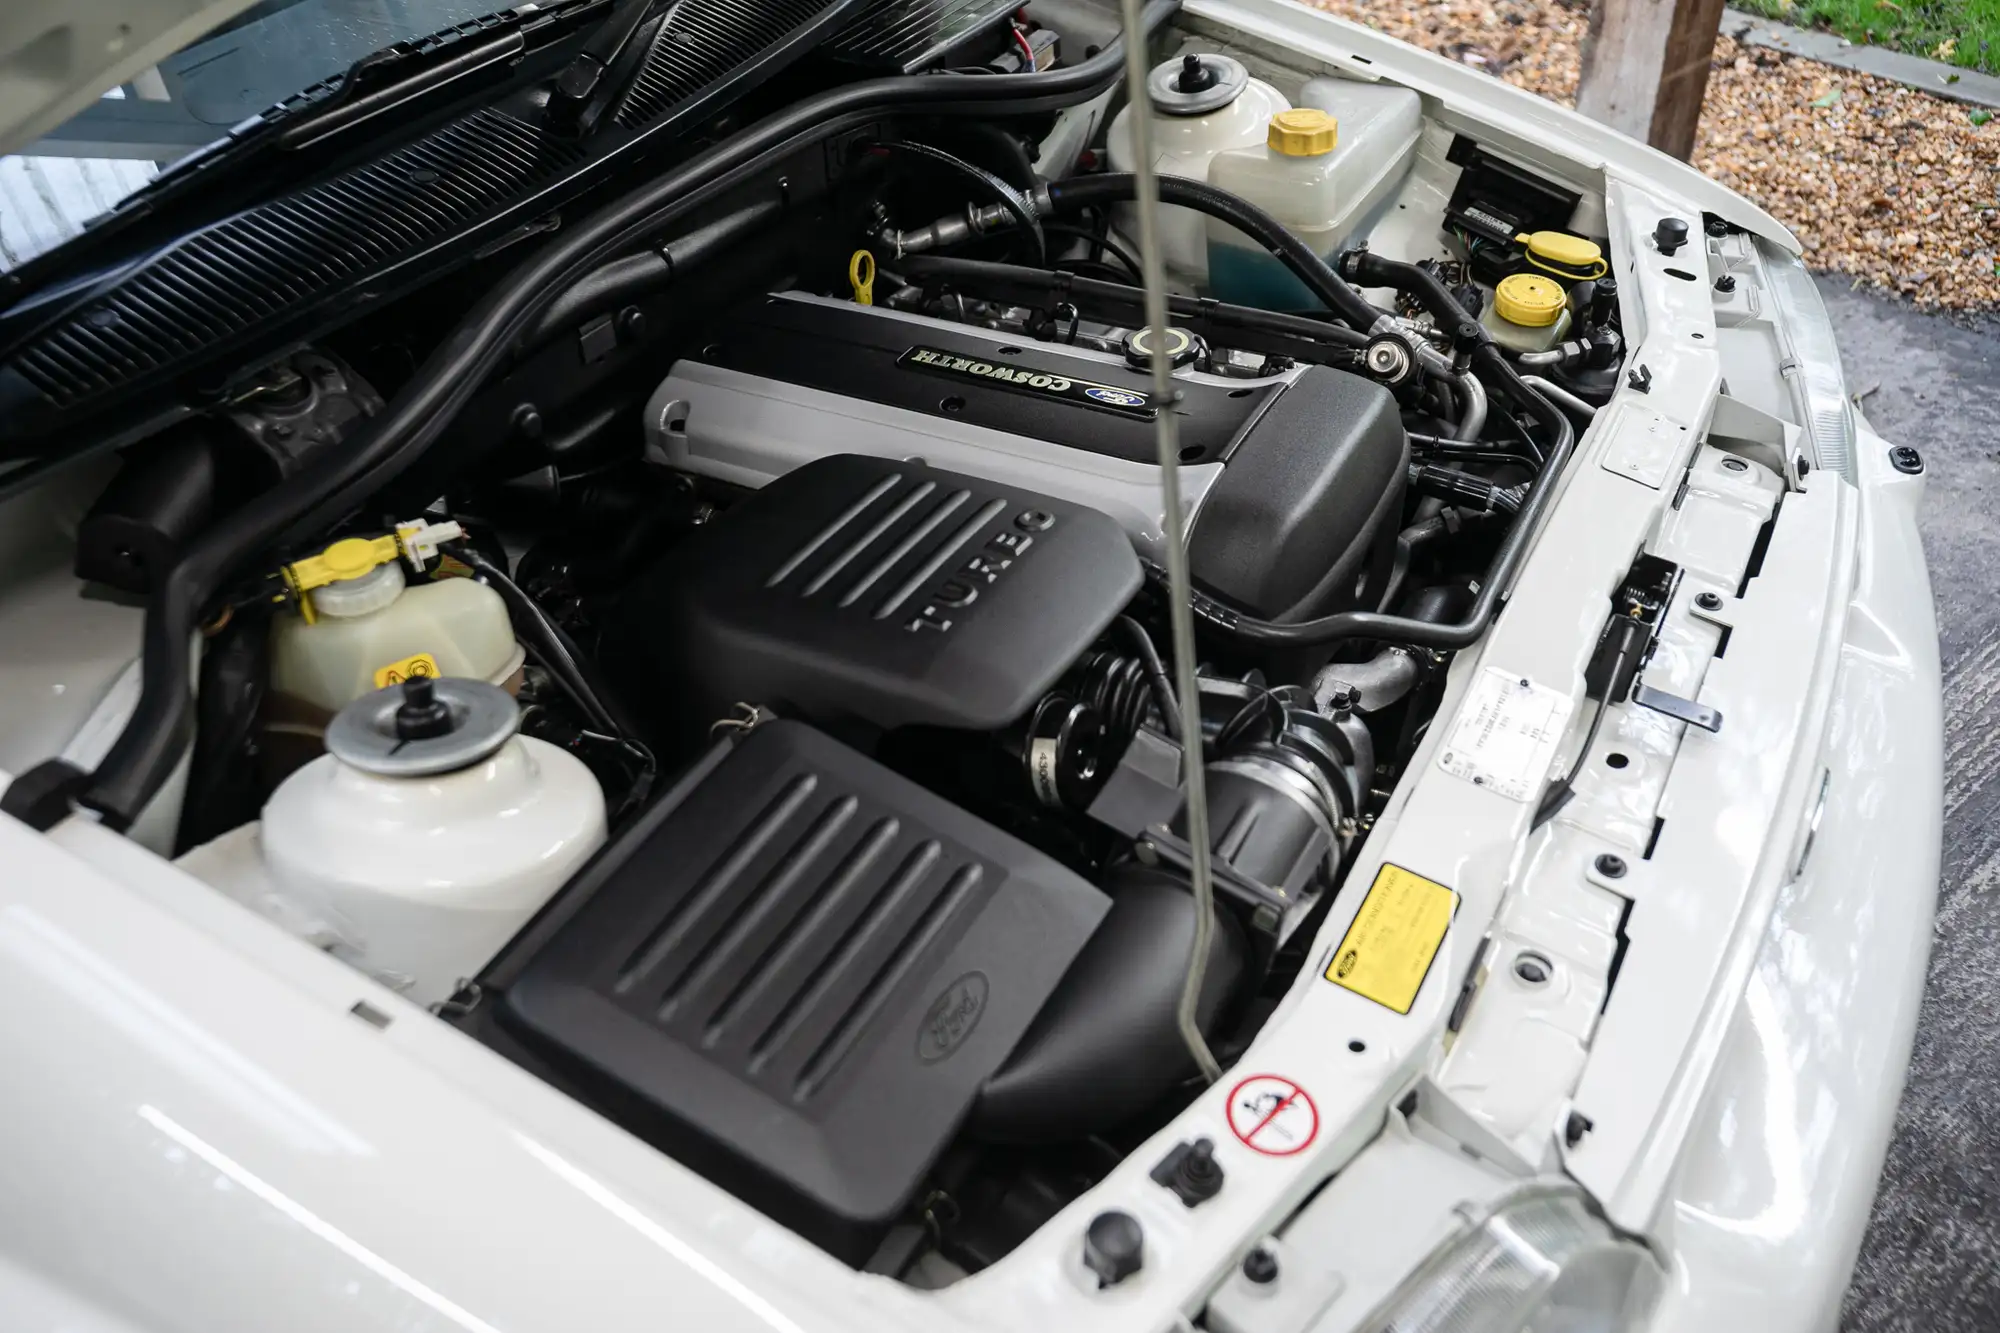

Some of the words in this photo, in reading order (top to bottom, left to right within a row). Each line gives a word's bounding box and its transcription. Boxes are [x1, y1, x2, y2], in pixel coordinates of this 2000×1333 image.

[911, 350, 1071, 391] COSWORTH
[1096, 390, 1136, 404] Ford
[904, 510, 1056, 632] TURBO
